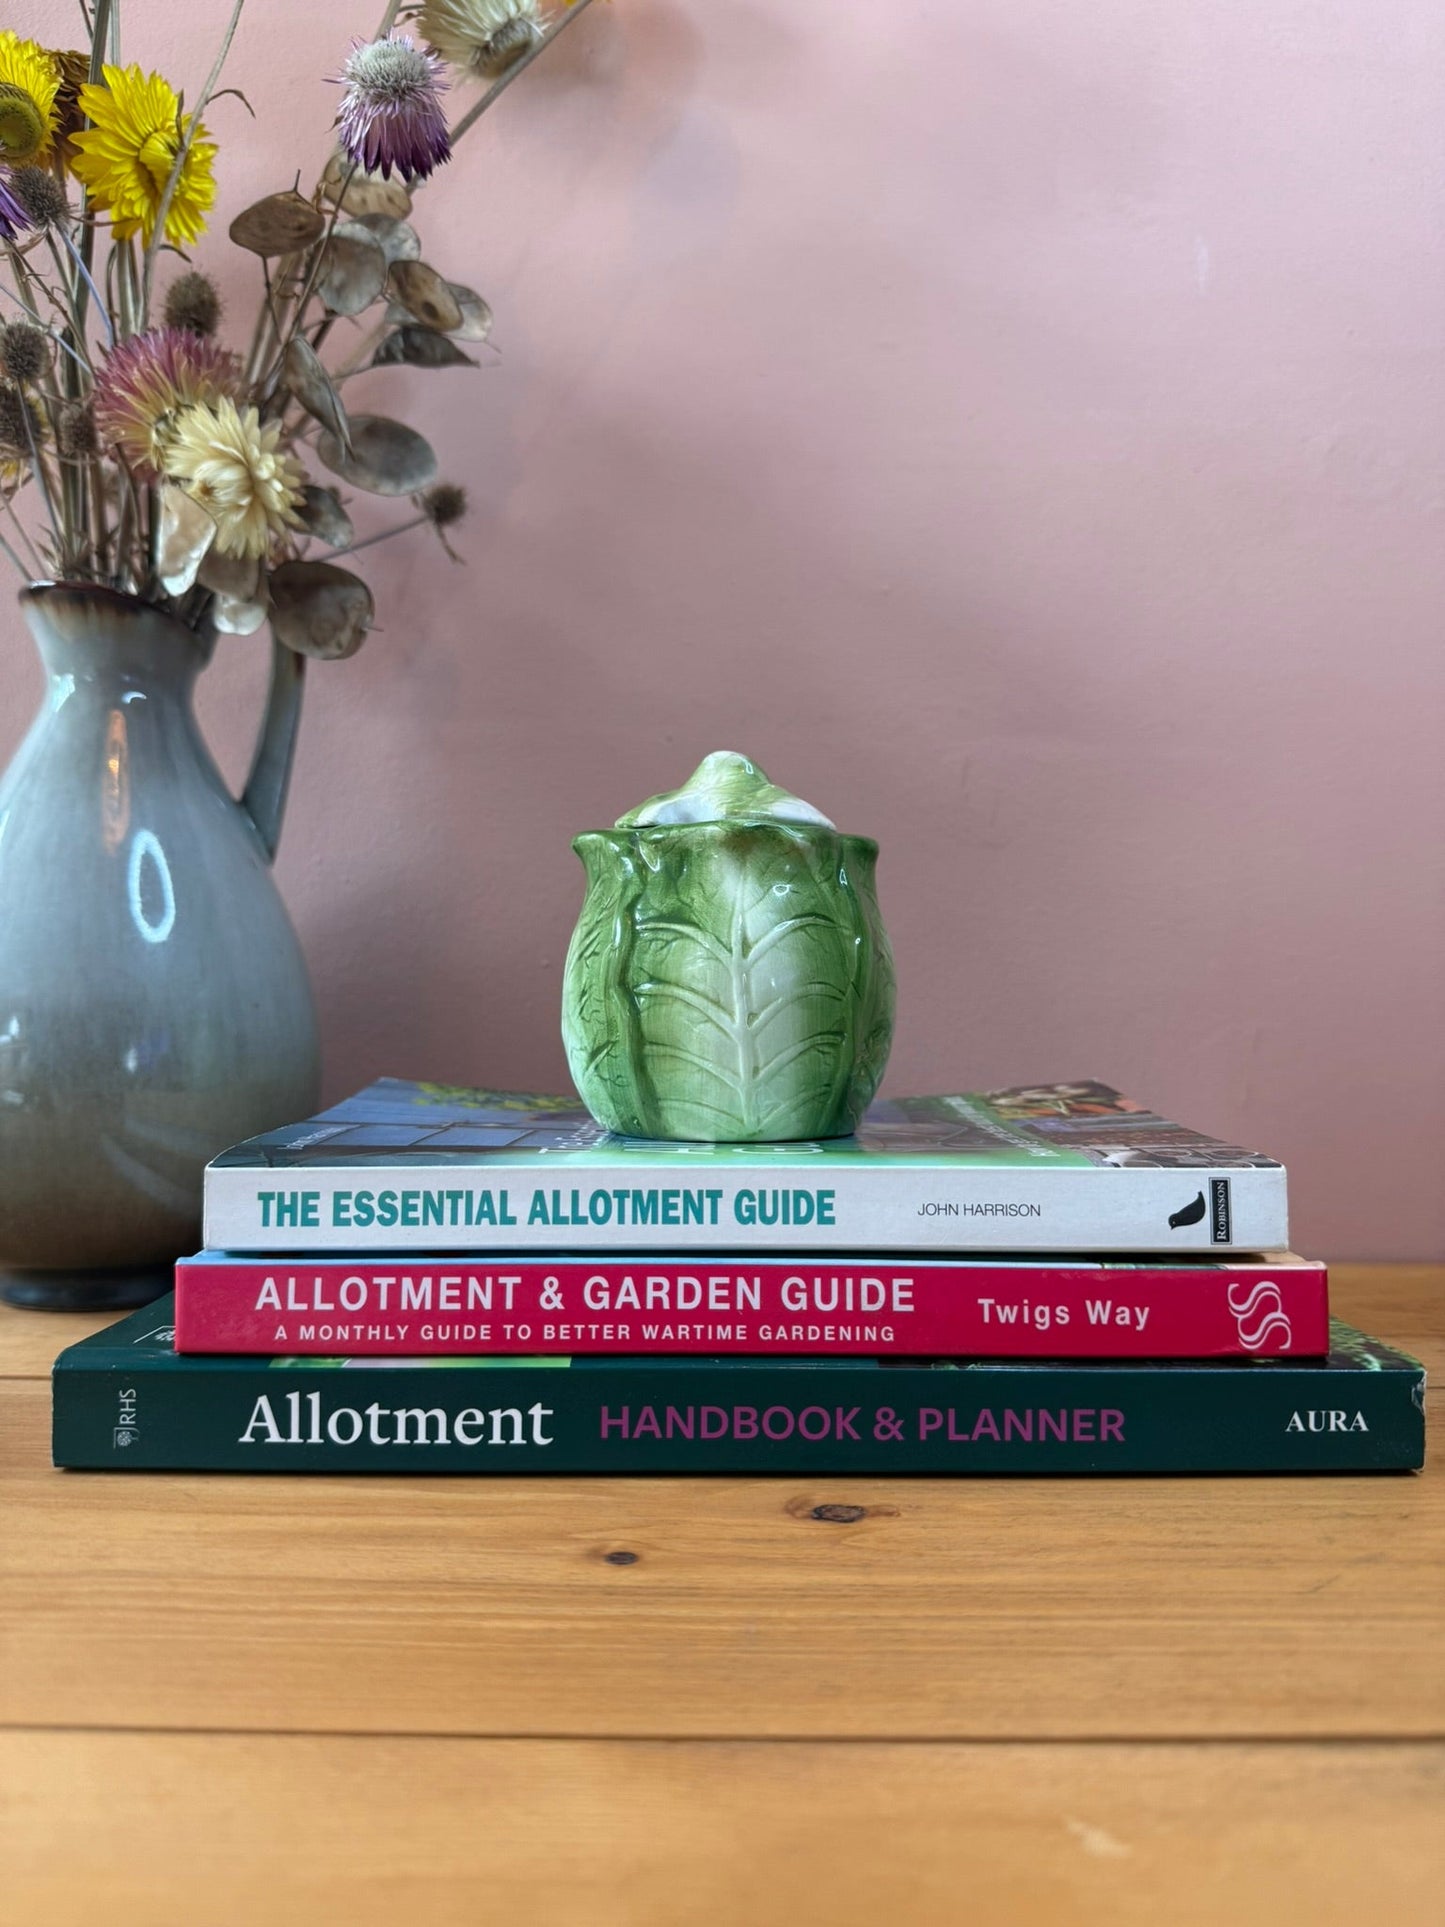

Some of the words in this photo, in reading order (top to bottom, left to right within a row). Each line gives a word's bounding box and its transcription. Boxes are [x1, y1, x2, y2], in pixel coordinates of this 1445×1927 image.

[257, 1191, 320, 1228] THE
[332, 1190, 517, 1228] ESSENTIAL
[527, 1189, 723, 1227] ALLOTMENT
[734, 1188, 836, 1226] GUIDE
[917, 1202, 959, 1217] JOHN
[963, 1203, 1042, 1218] HARRISON
[254, 1276, 522, 1312] ALLOTMENT
[539, 1276, 566, 1312] &
[583, 1276, 762, 1312] GARDEN
[780, 1276, 916, 1313] GUIDE
[977, 1298, 1070, 1331] Twigs
[1085, 1300, 1150, 1331] Way
[274, 1324, 288, 1341] A
[299, 1324, 409, 1341] MONTHLY
[420, 1324, 491, 1341] GUIDE
[503, 1324, 532, 1341] TO
[543, 1324, 630, 1341] BETTER
[642, 1324, 748, 1341] WARTIME
[758, 1324, 896, 1342] GARDENING
[119, 1388, 137, 1425] RHS
[238, 1391, 554, 1446] Allotment
[600, 1406, 862, 1441] HANDBOOK
[873, 1406, 905, 1441] &
[918, 1408, 1126, 1442] PLANNER
[1285, 1410, 1370, 1432] AURA
